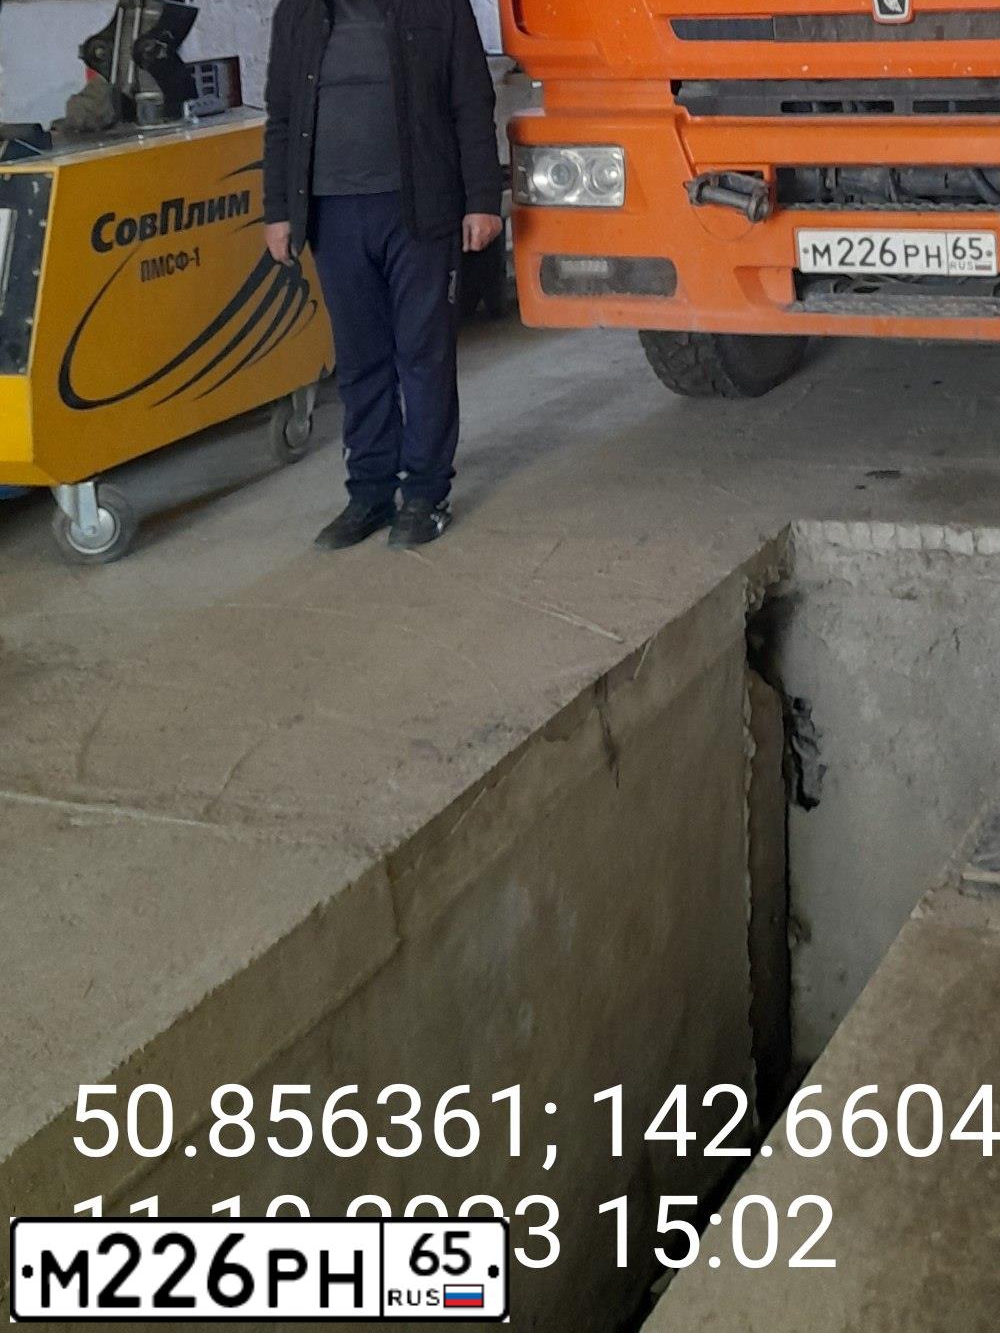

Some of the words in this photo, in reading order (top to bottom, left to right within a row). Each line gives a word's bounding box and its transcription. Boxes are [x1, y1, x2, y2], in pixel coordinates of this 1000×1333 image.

[91, 190, 250, 252] СовПлим
[141, 247, 201, 282] ПМСФ-1
[812, 237, 942, 268] М226РН
[952, 237, 983, 260] 65
[950, 261, 974, 271] RUS
